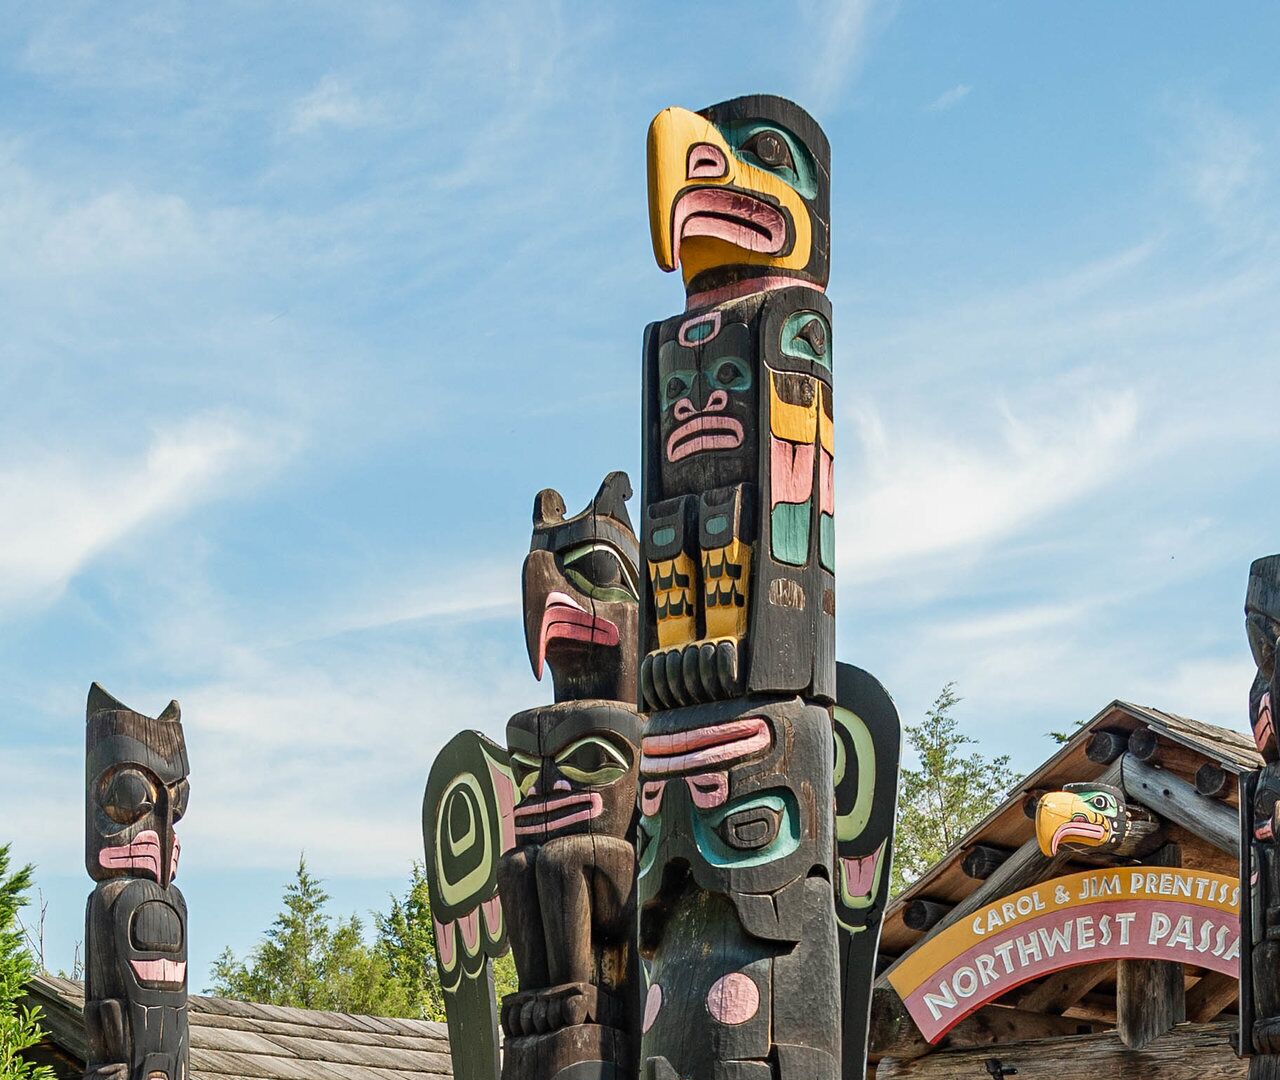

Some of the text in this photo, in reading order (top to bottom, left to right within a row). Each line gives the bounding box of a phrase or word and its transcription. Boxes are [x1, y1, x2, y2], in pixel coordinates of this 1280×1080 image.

[971, 872, 1240, 936] CAROL & JIM PRENTISS
[923, 911, 1240, 1021] NORTHWEST PASSA
